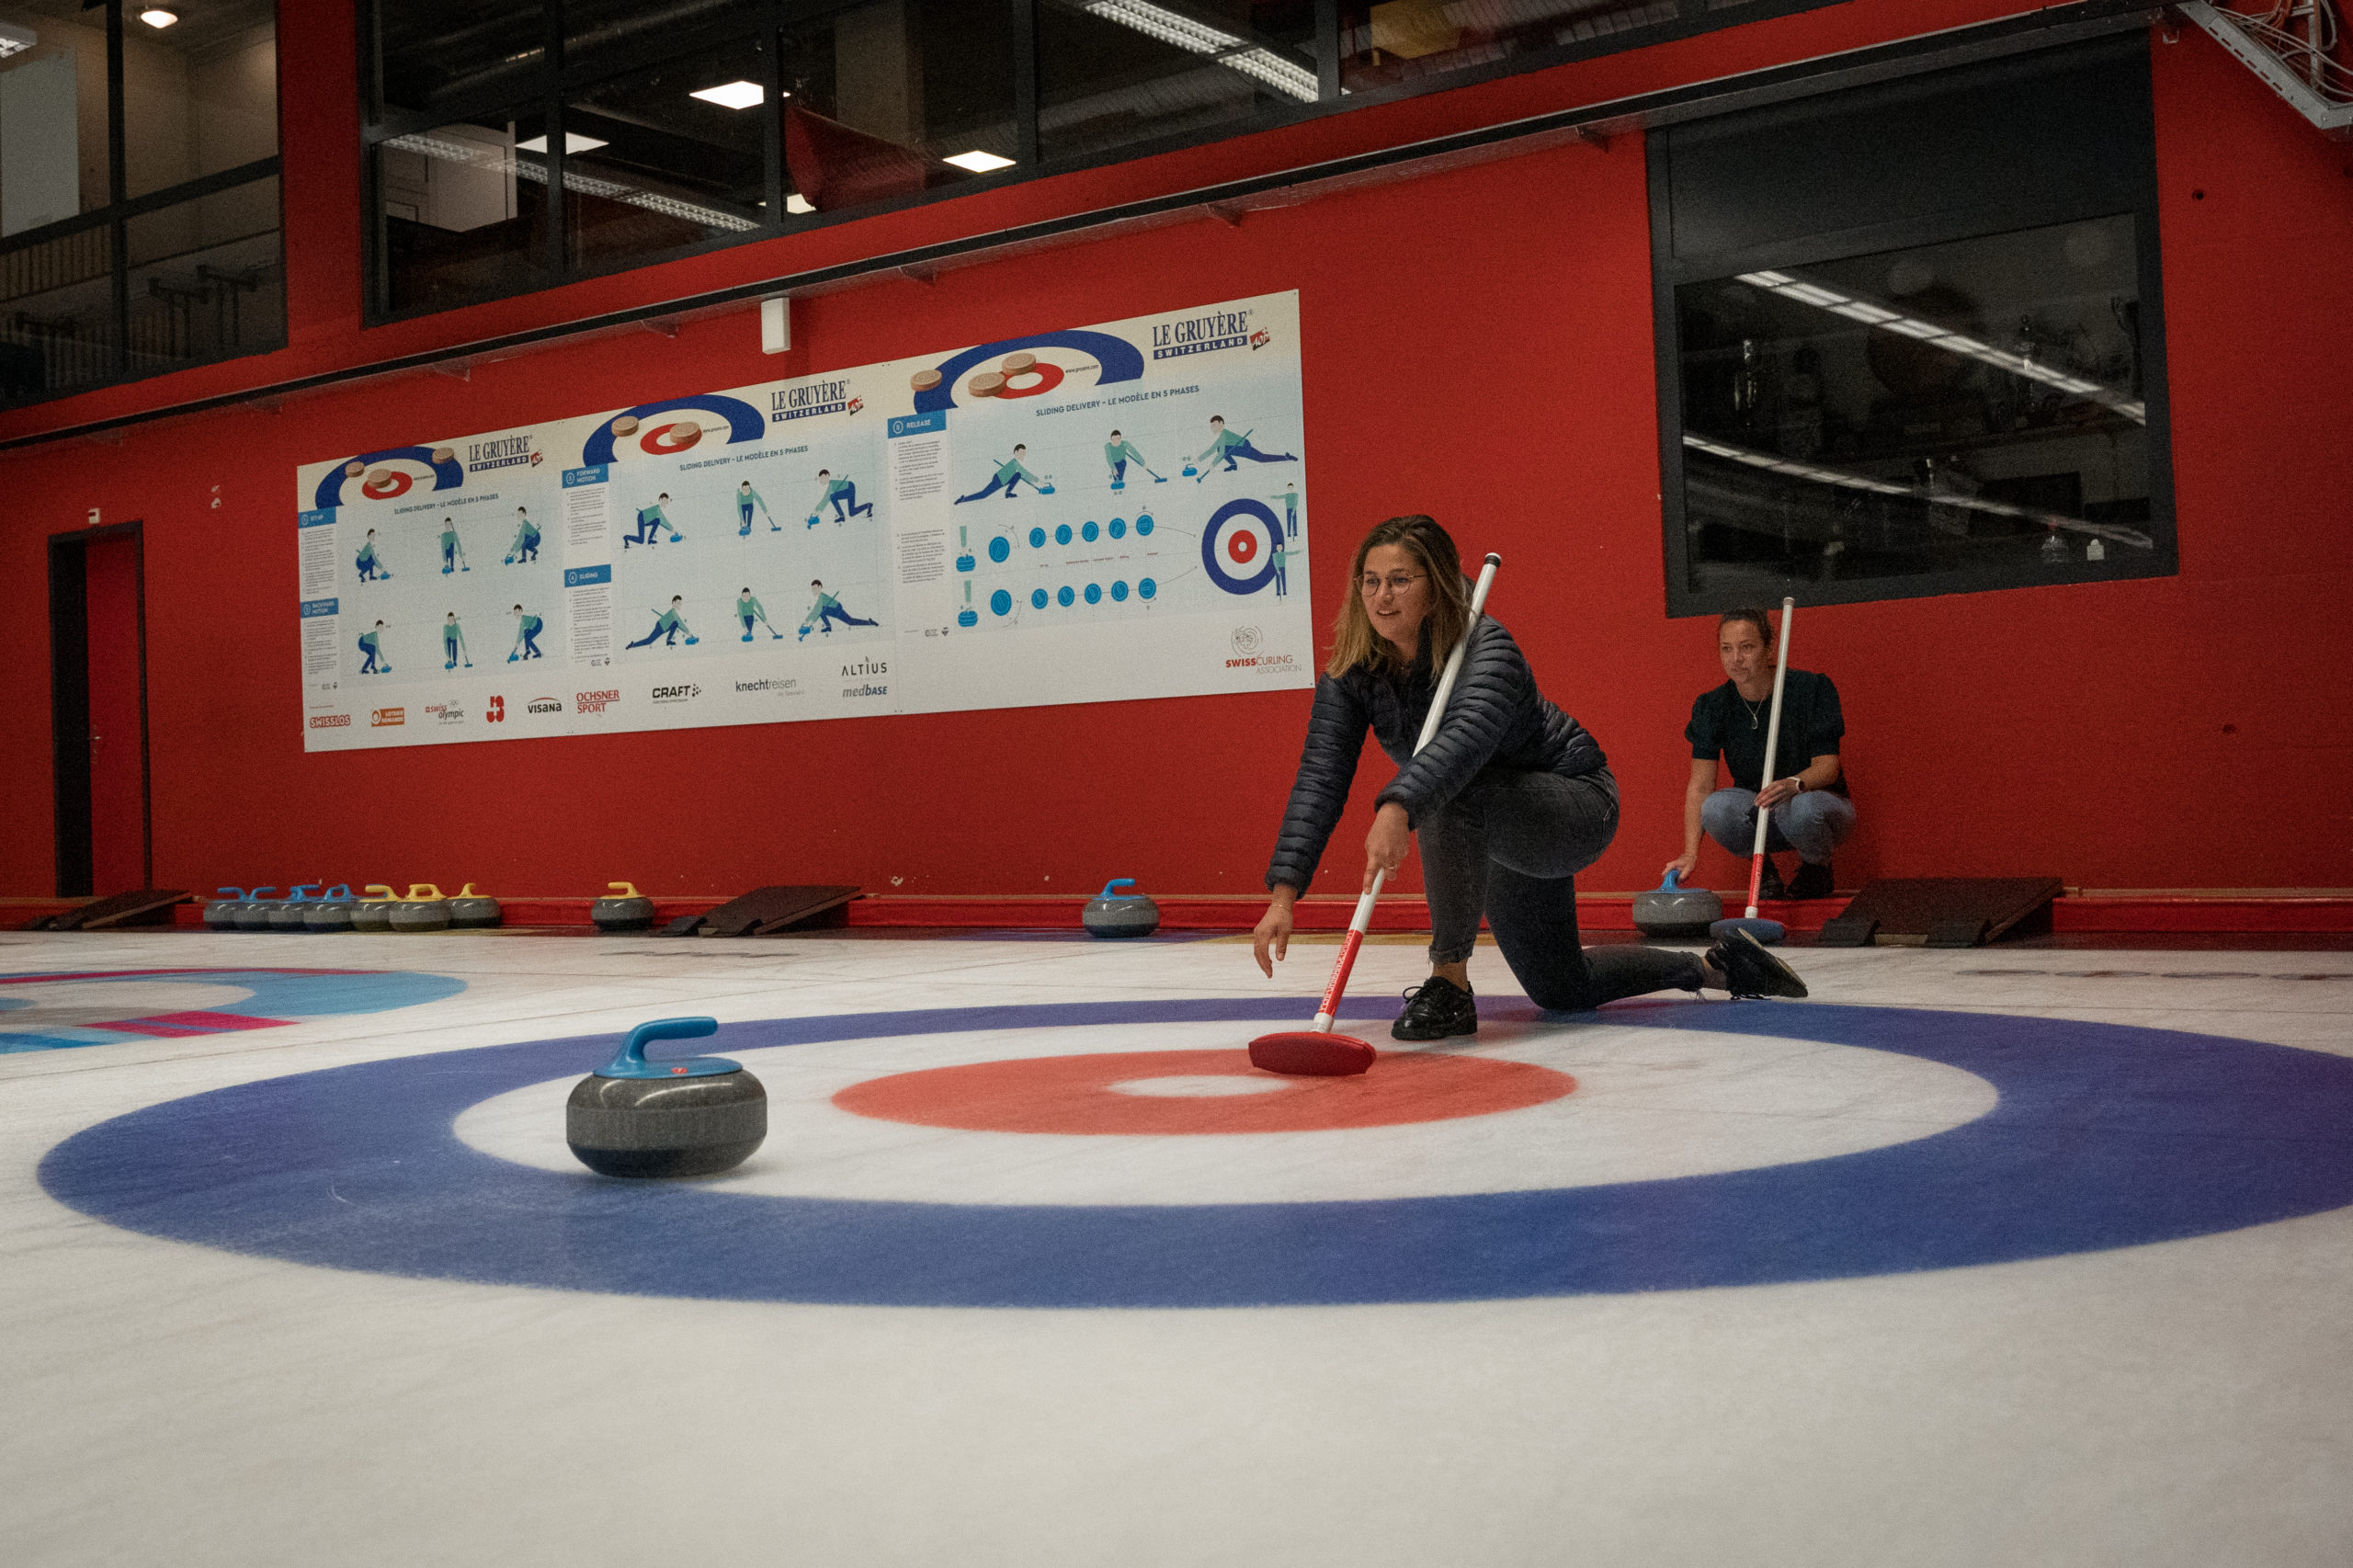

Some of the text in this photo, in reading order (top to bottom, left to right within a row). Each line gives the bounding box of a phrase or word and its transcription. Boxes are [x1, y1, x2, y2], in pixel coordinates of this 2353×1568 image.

[1153, 311, 1248, 347] LE GRUYÈRE
[1157, 336, 1244, 358] SWITZERLAND
[772, 379, 846, 411] LE GRUYÈRE
[1036, 404, 1064, 417] SLIDING
[1066, 400, 1101, 412] DELIVERY
[1108, 397, 1117, 405] LE
[1119, 392, 1149, 404] MODÈLE
[1151, 391, 1162, 400] EN
[1170, 384, 1199, 396] PHASES
[775, 403, 843, 421] SWITZERLAND
[906, 419, 931, 428] RELEASE
[469, 444, 481, 462] LE
[483, 435, 529, 460] GRUYÈRE
[472, 456, 527, 471] SWITZERLAND
[679, 461, 702, 472] SLIDING
[703, 457, 731, 468] DELIVERY
[745, 449, 769, 460] MODÈLE
[770, 449, 779, 457] EN
[785, 445, 809, 455] PHASES
[1256, 664, 1302, 675] ASSOCIATION
[652, 685, 691, 699] CRAFT
[735, 677, 797, 692] knechtreisen
[575, 689, 620, 702] OCHSNER
[430, 702, 448, 712] swiss
[438, 708, 464, 721] olympic
[577, 702, 607, 714] SPORT
[310, 714, 350, 728] SWISSLOS
